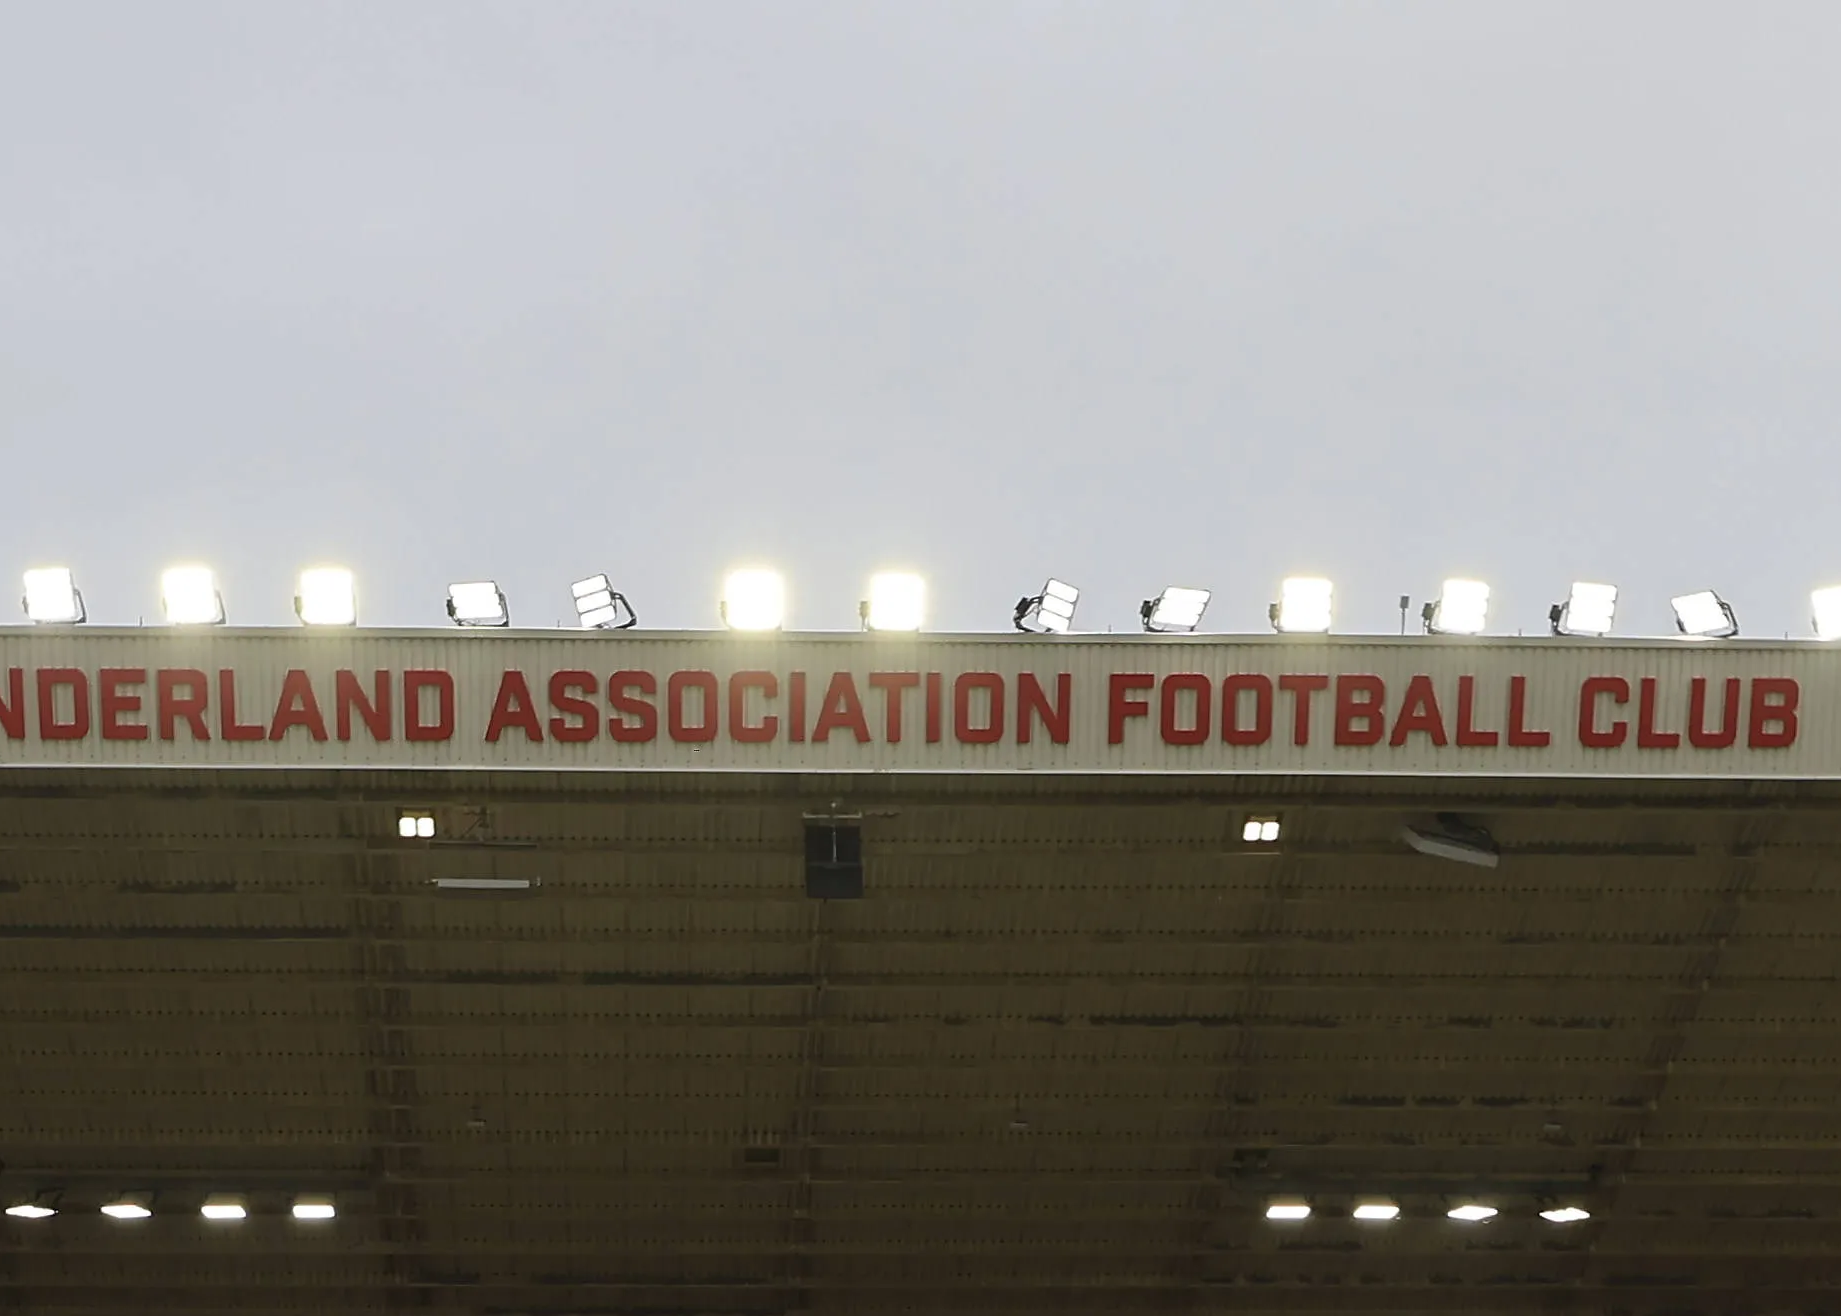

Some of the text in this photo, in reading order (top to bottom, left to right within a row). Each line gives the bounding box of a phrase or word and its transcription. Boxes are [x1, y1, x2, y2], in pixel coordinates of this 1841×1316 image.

[489, 671, 1069, 742] ASSOCIATION
[1111, 674, 1549, 745] FOOTBALL
[1582, 677, 1799, 747] CLUB
